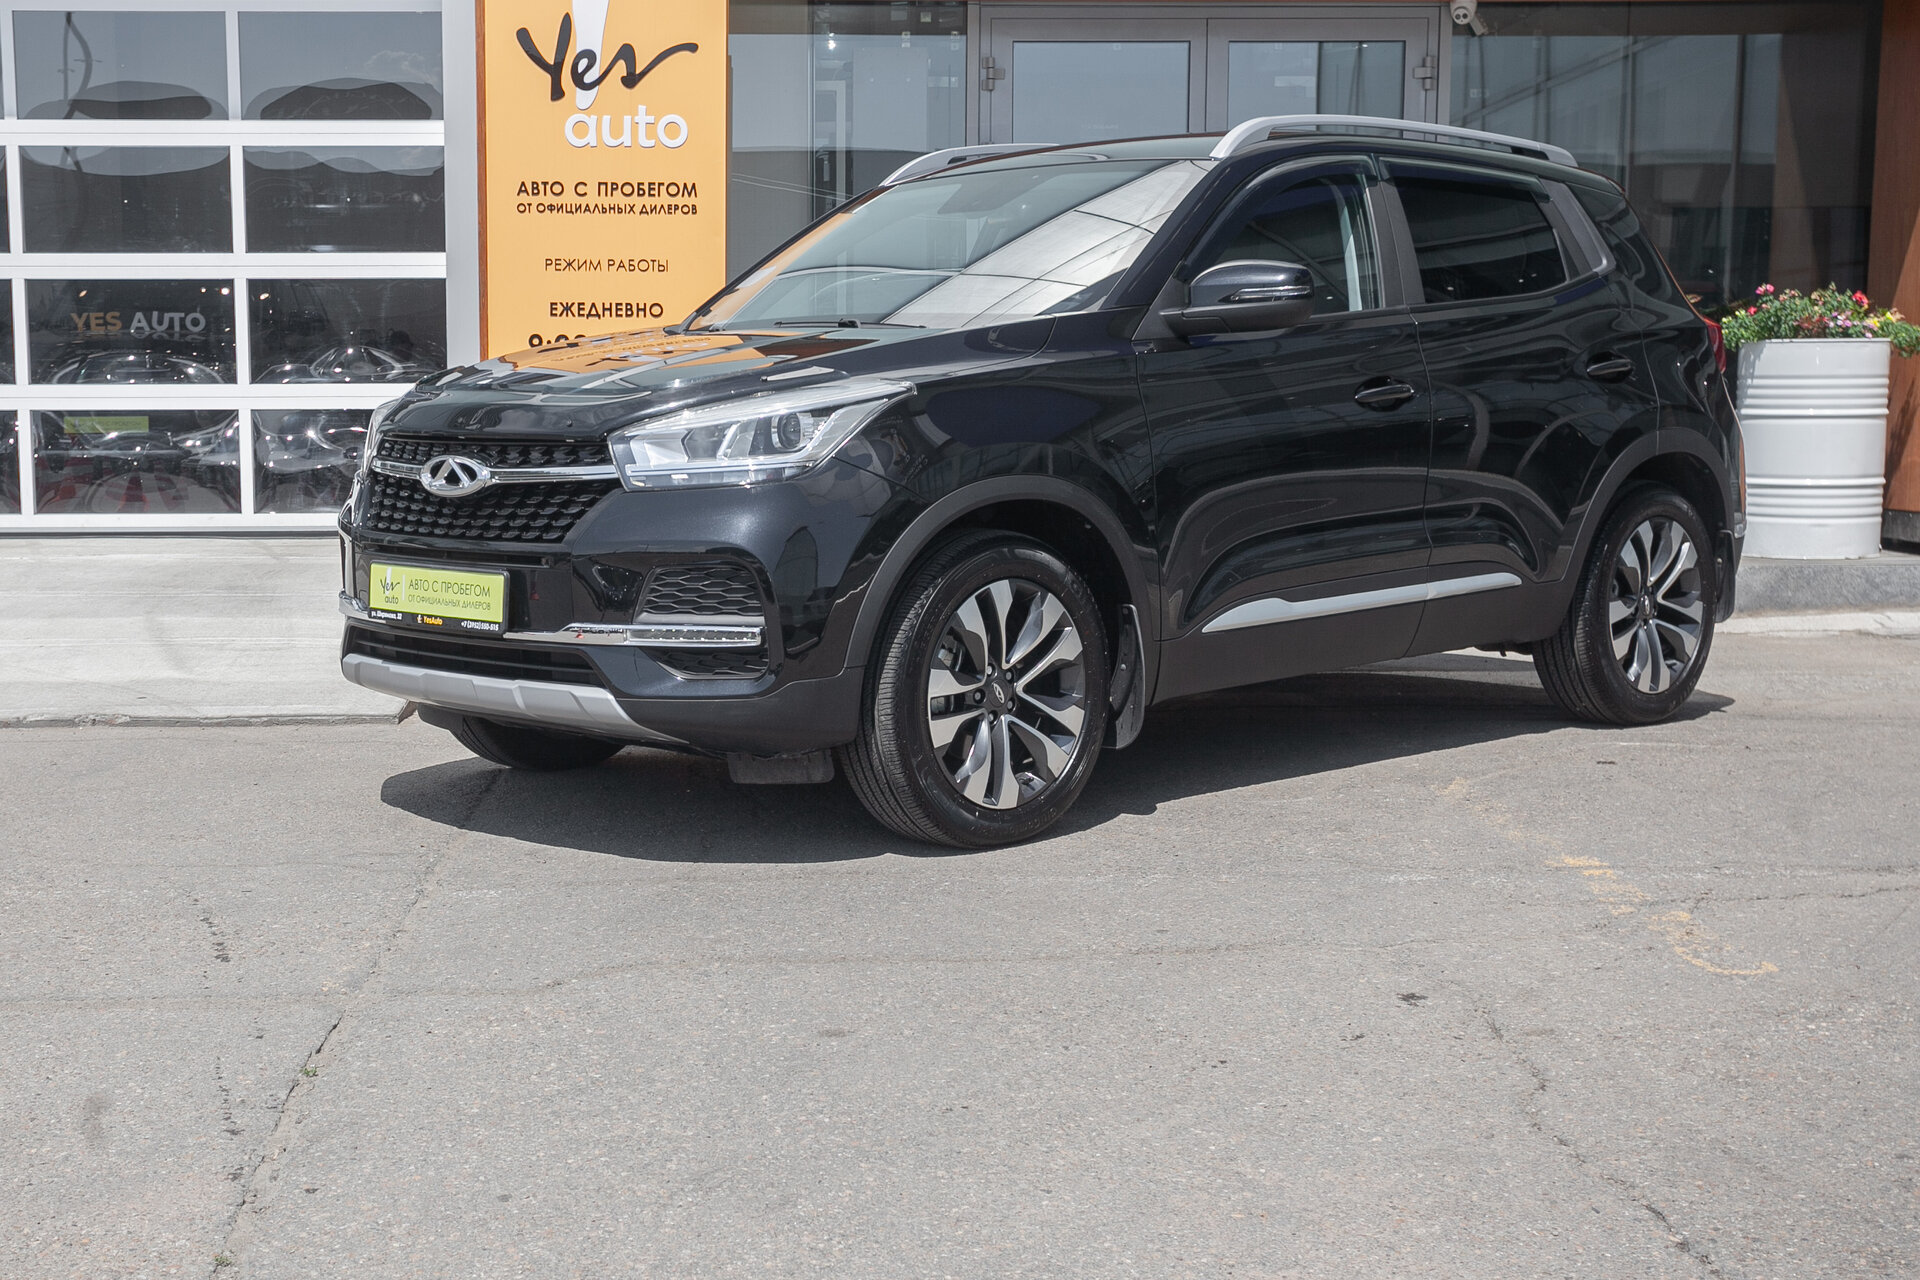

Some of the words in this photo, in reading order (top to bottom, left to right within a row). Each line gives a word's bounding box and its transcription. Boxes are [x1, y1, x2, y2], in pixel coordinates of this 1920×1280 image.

[516, 12, 699, 102] Yes
[564, 104, 689, 149] auto
[517, 181, 565, 197] АВТО
[574, 182, 588, 197] С
[597, 182, 698, 198] ПРОБЕГОМ
[516, 203, 532, 214] ОТ
[536, 203, 636, 215] ОФИЦИАЛЬНЫХ
[639, 203, 698, 215] ДИЛЕРОВ
[545, 258, 602, 272] РЕЖИМ
[607, 259, 669, 273] РАБОТЫ
[549, 302, 664, 319] ЕЖЕДНЕВНО
[70, 311, 122, 332] YES
[130, 311, 206, 332] AUTO
[408, 579, 430, 591] АВТО
[432, 580, 439, 592] С
[441, 581, 491, 598] ПРОБЕГОМ
[385, 595, 399, 604] auto
[461, 600, 491, 611] ДИЛЕРОВ
